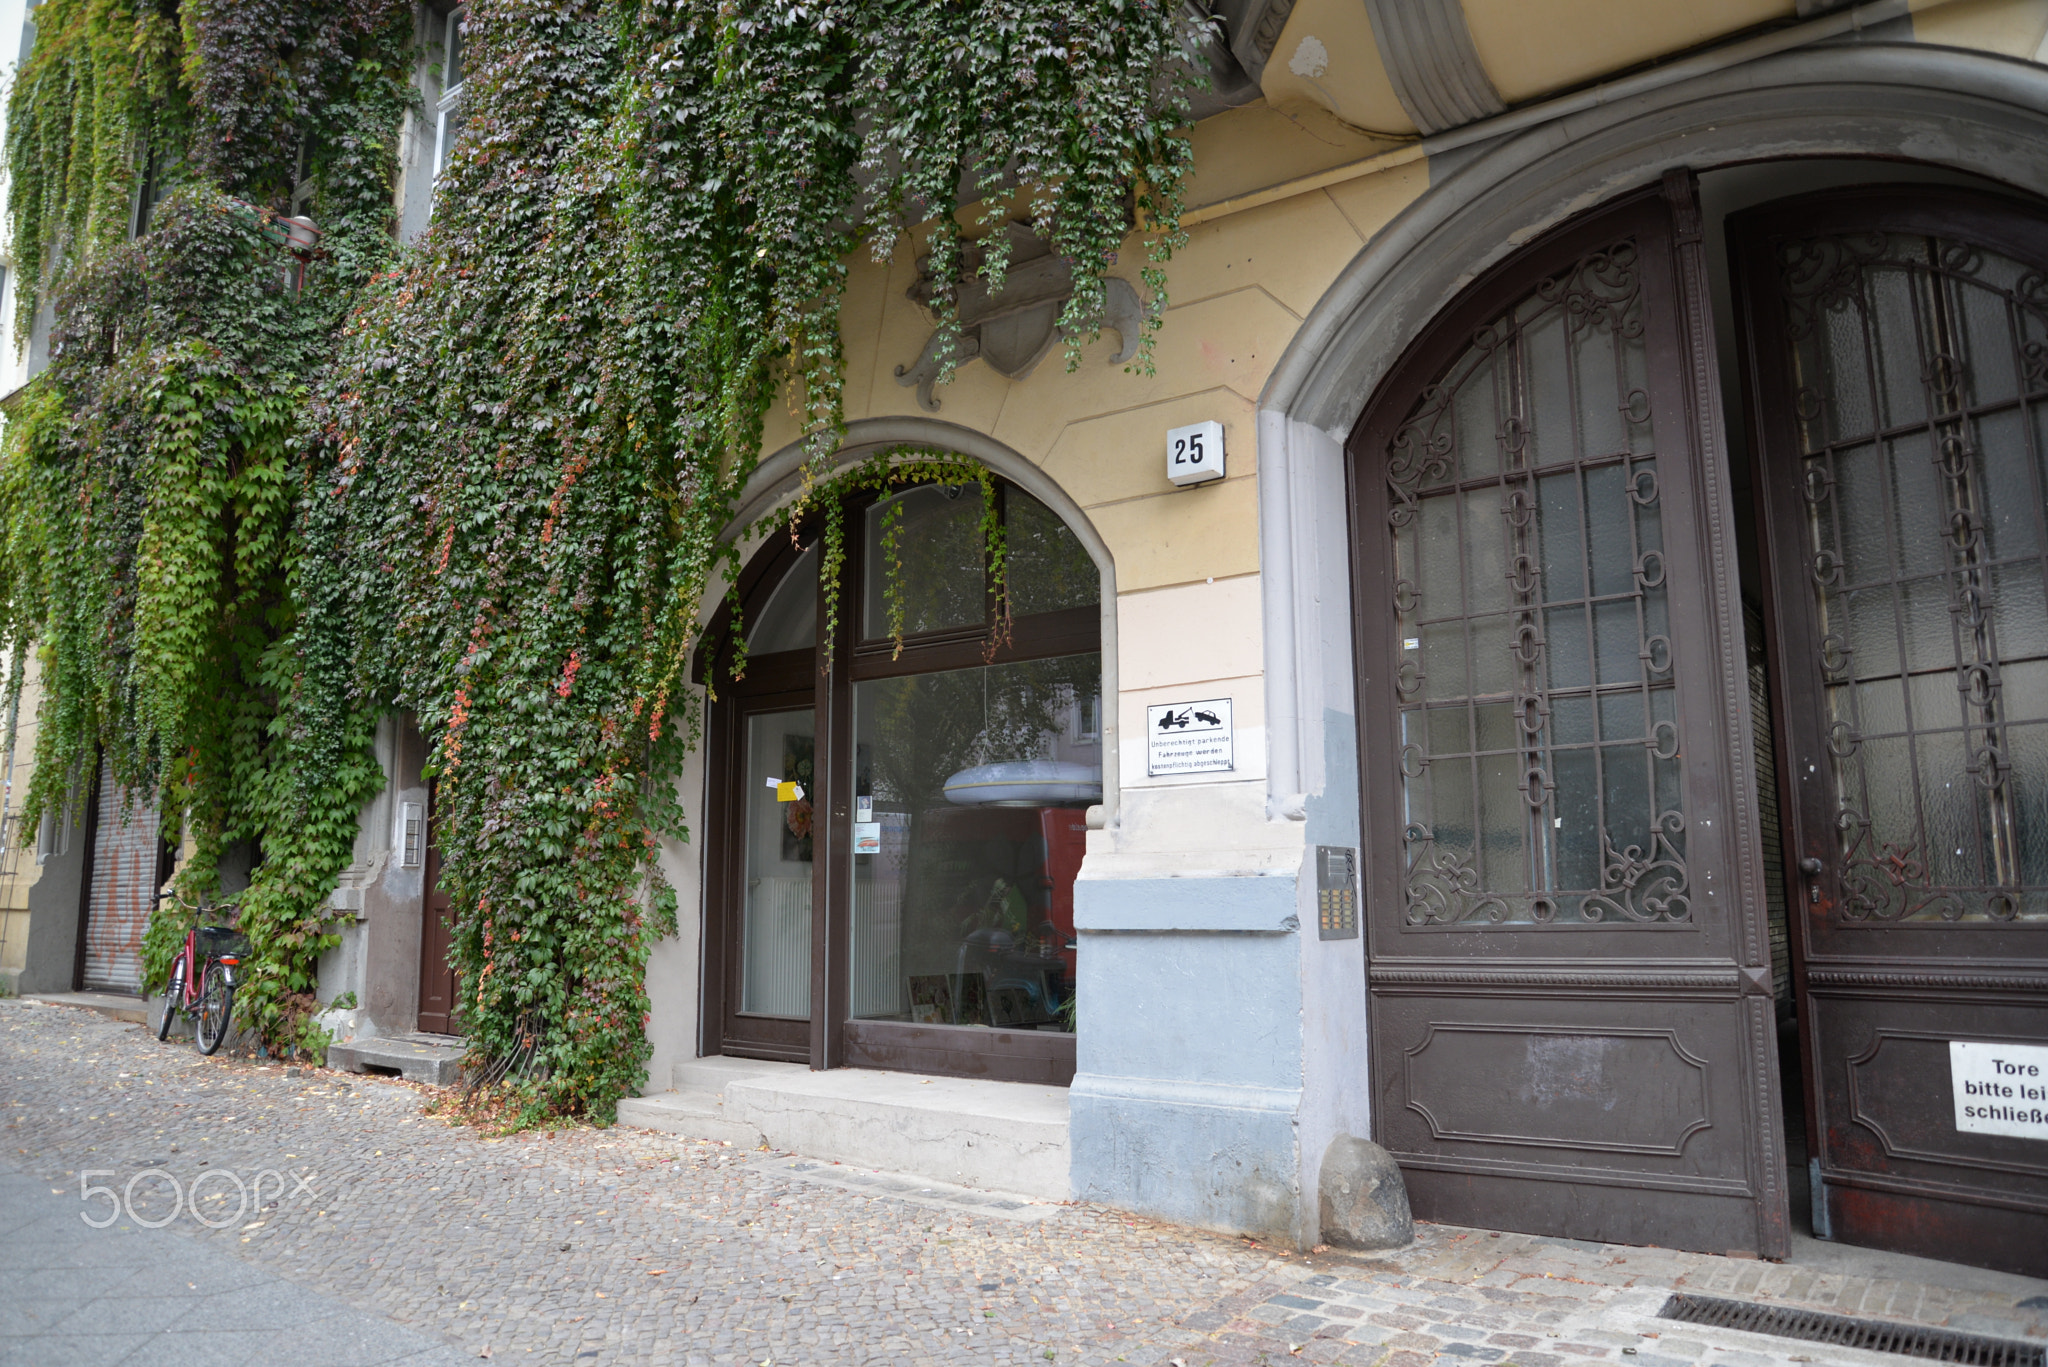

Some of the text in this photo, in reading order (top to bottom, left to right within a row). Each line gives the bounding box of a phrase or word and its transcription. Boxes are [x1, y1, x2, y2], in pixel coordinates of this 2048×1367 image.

[1175, 433, 1204, 464] 25
[1151, 736, 1230, 748] Unberechtigt parkende
[1158, 750, 1193, 758] Fahrzeuge
[1991, 1059, 2039, 1076] Tore
[1965, 1080, 2013, 1097] bitte
